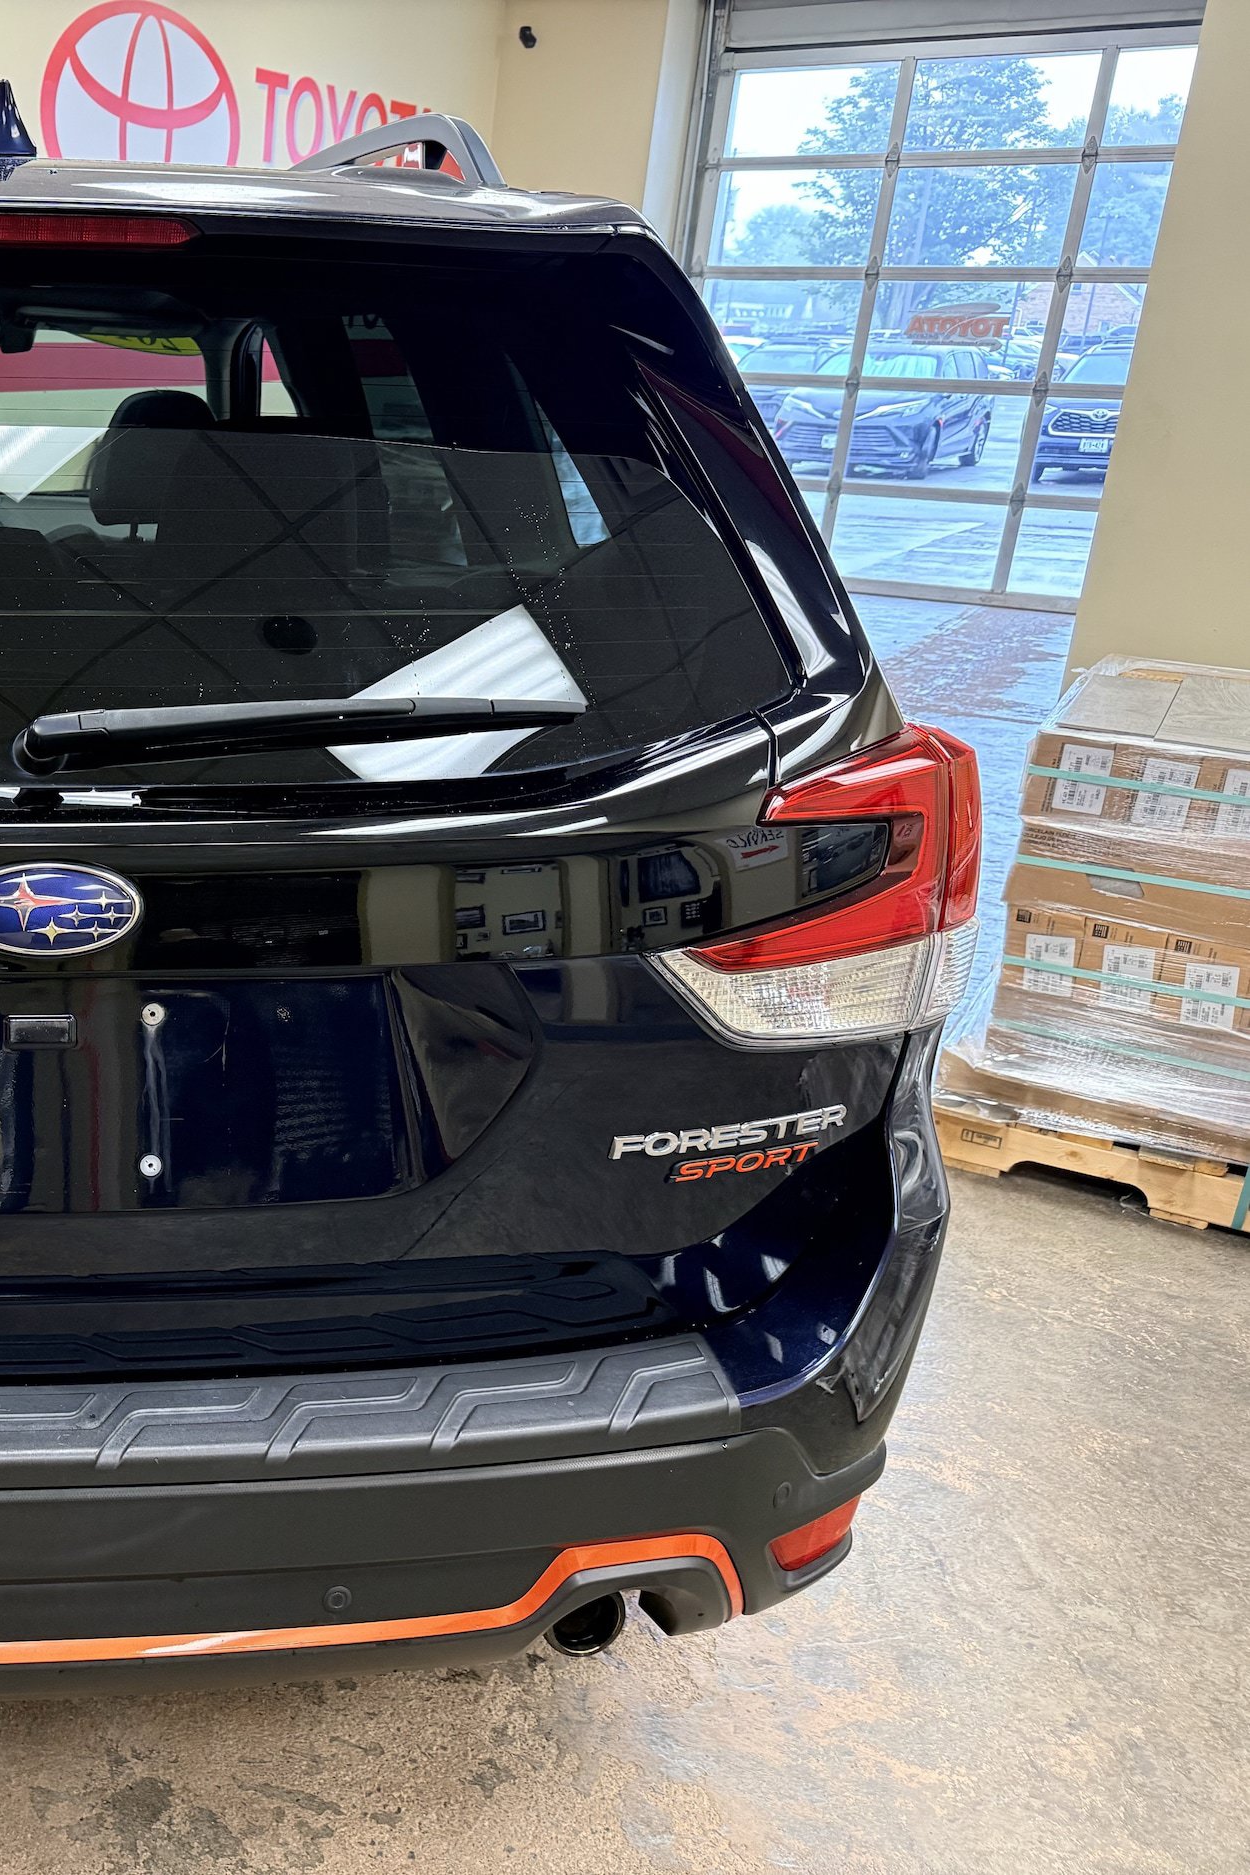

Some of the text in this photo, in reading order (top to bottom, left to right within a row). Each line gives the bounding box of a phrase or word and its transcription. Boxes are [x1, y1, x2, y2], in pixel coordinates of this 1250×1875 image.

[255, 67, 433, 166] TOYOT
[609, 1104, 847, 1160] FORESTER
[672, 1142, 819, 1183] SPORT
